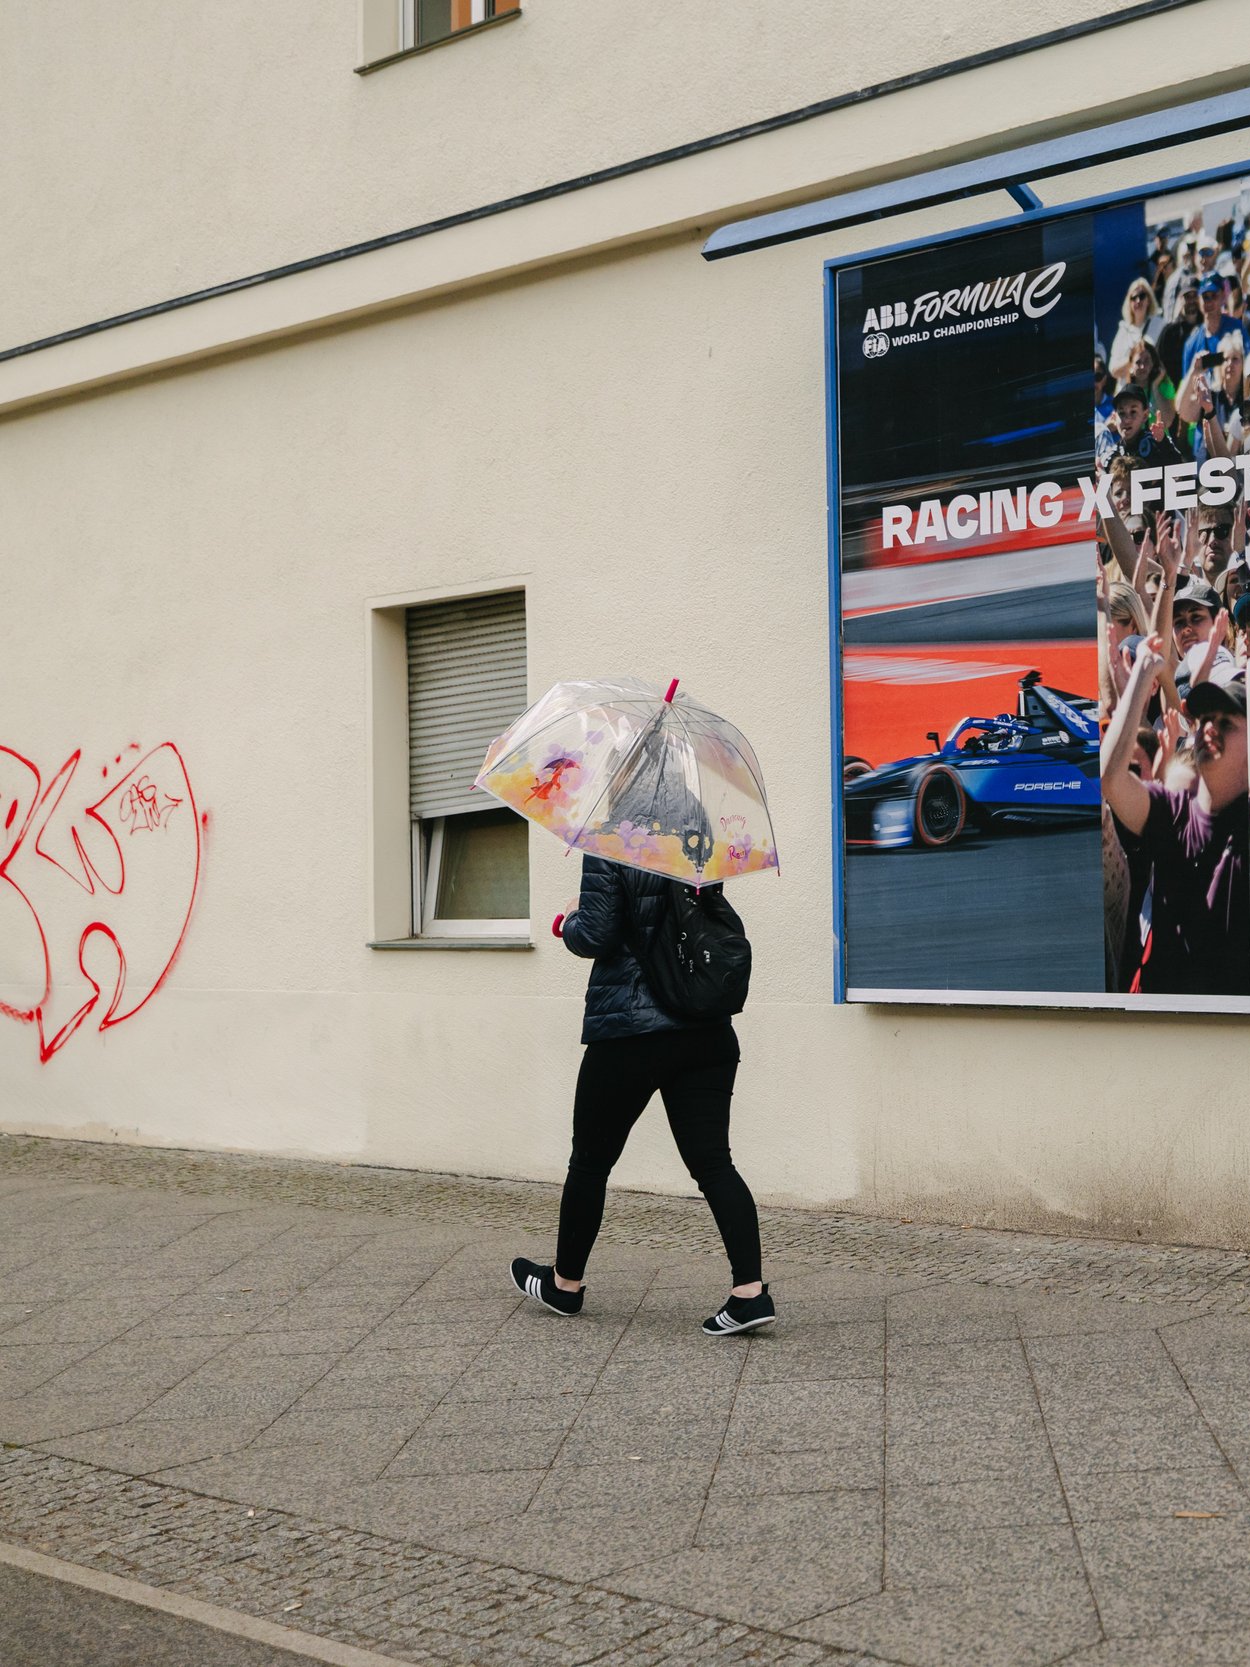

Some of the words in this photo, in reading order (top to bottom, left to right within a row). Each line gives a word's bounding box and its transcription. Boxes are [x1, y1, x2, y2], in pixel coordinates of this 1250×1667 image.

[862, 301, 909, 333] ABB
[909, 271, 1027, 328] FORMULA
[864, 335, 888, 355] FIA
[892, 330, 930, 347] WORLD
[933, 312, 1020, 339] CHAMPIONSHIP
[881, 480, 1064, 550] RACING
[1078, 473, 1115, 522] X
[1013, 780, 1082, 792] PORSCHE
